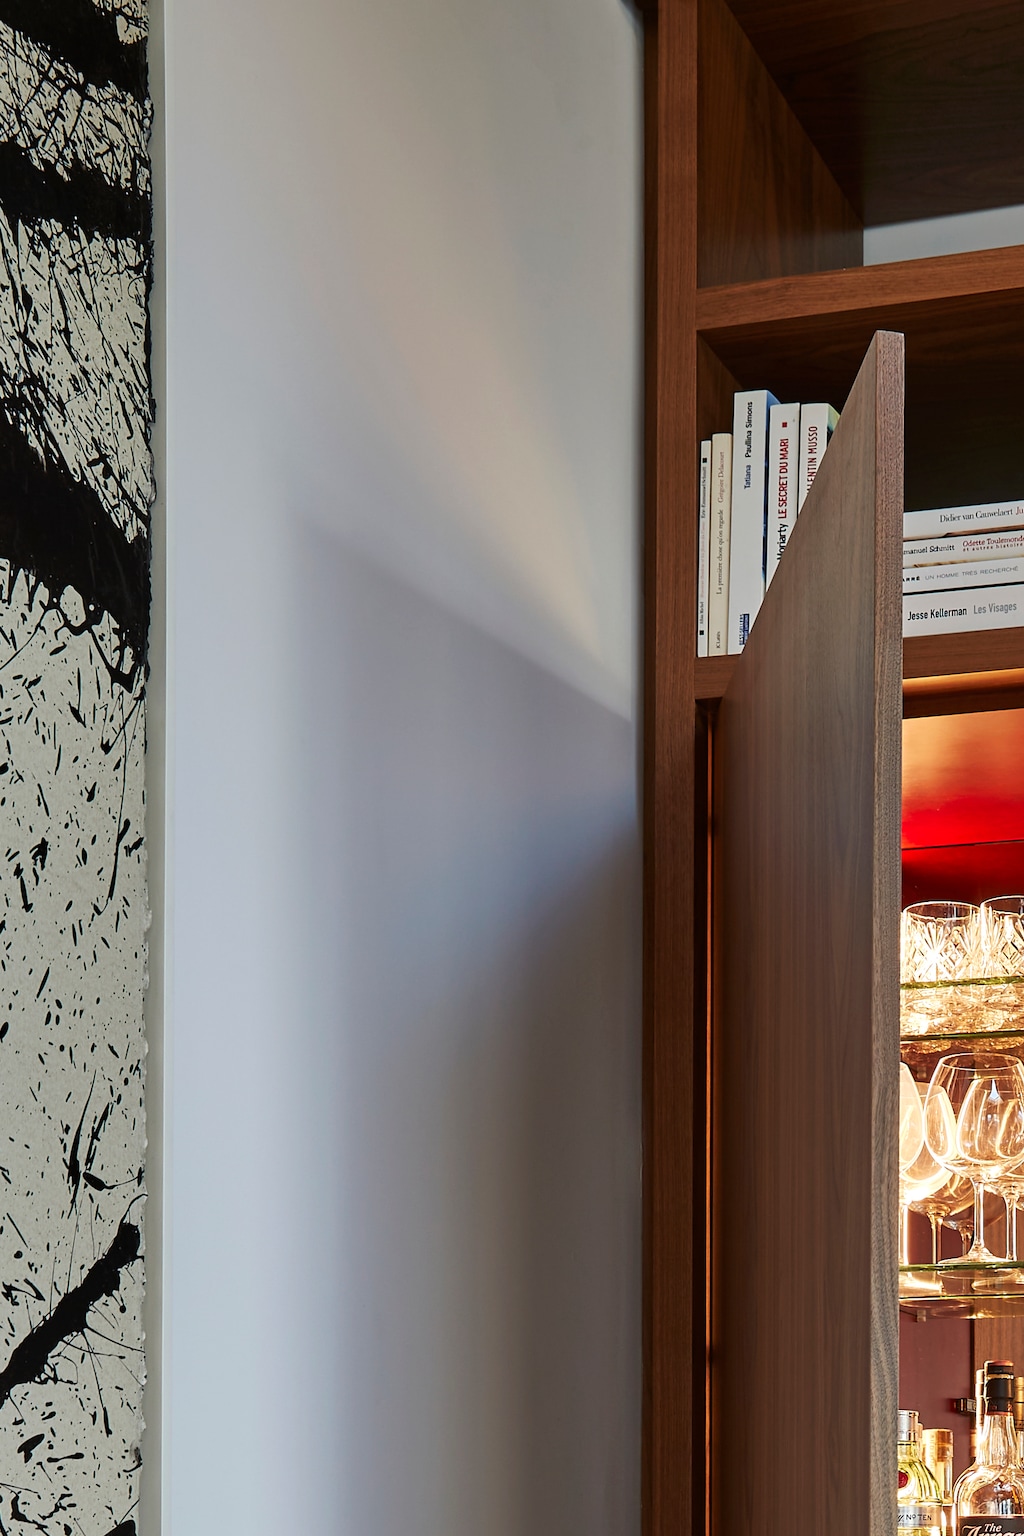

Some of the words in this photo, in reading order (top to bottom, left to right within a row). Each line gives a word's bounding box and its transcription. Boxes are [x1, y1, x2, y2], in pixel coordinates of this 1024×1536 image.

[808, 426, 818, 454] MUSSO
[779, 438, 789, 460] MARI
[780, 462, 788, 474] DU
[778, 474, 788, 507] SECRET
[717, 509, 725, 530] regarde
[778, 508, 787, 519] LE
[939, 514, 961, 523] Didier
[975, 509, 1013, 519] Cauwelaert
[929, 544, 955, 553] Schmitt
[962, 538, 985, 547] Odette
[980, 565, 1019, 574] RECHERCHÉ
[716, 586, 723, 595] La
[907, 611, 928, 621] Jesse
[930, 607, 967, 618] Kellerman
[974, 605, 986, 614] Les
[988, 602, 1017, 614] Visages
[984, 1523, 1002, 1532] The
